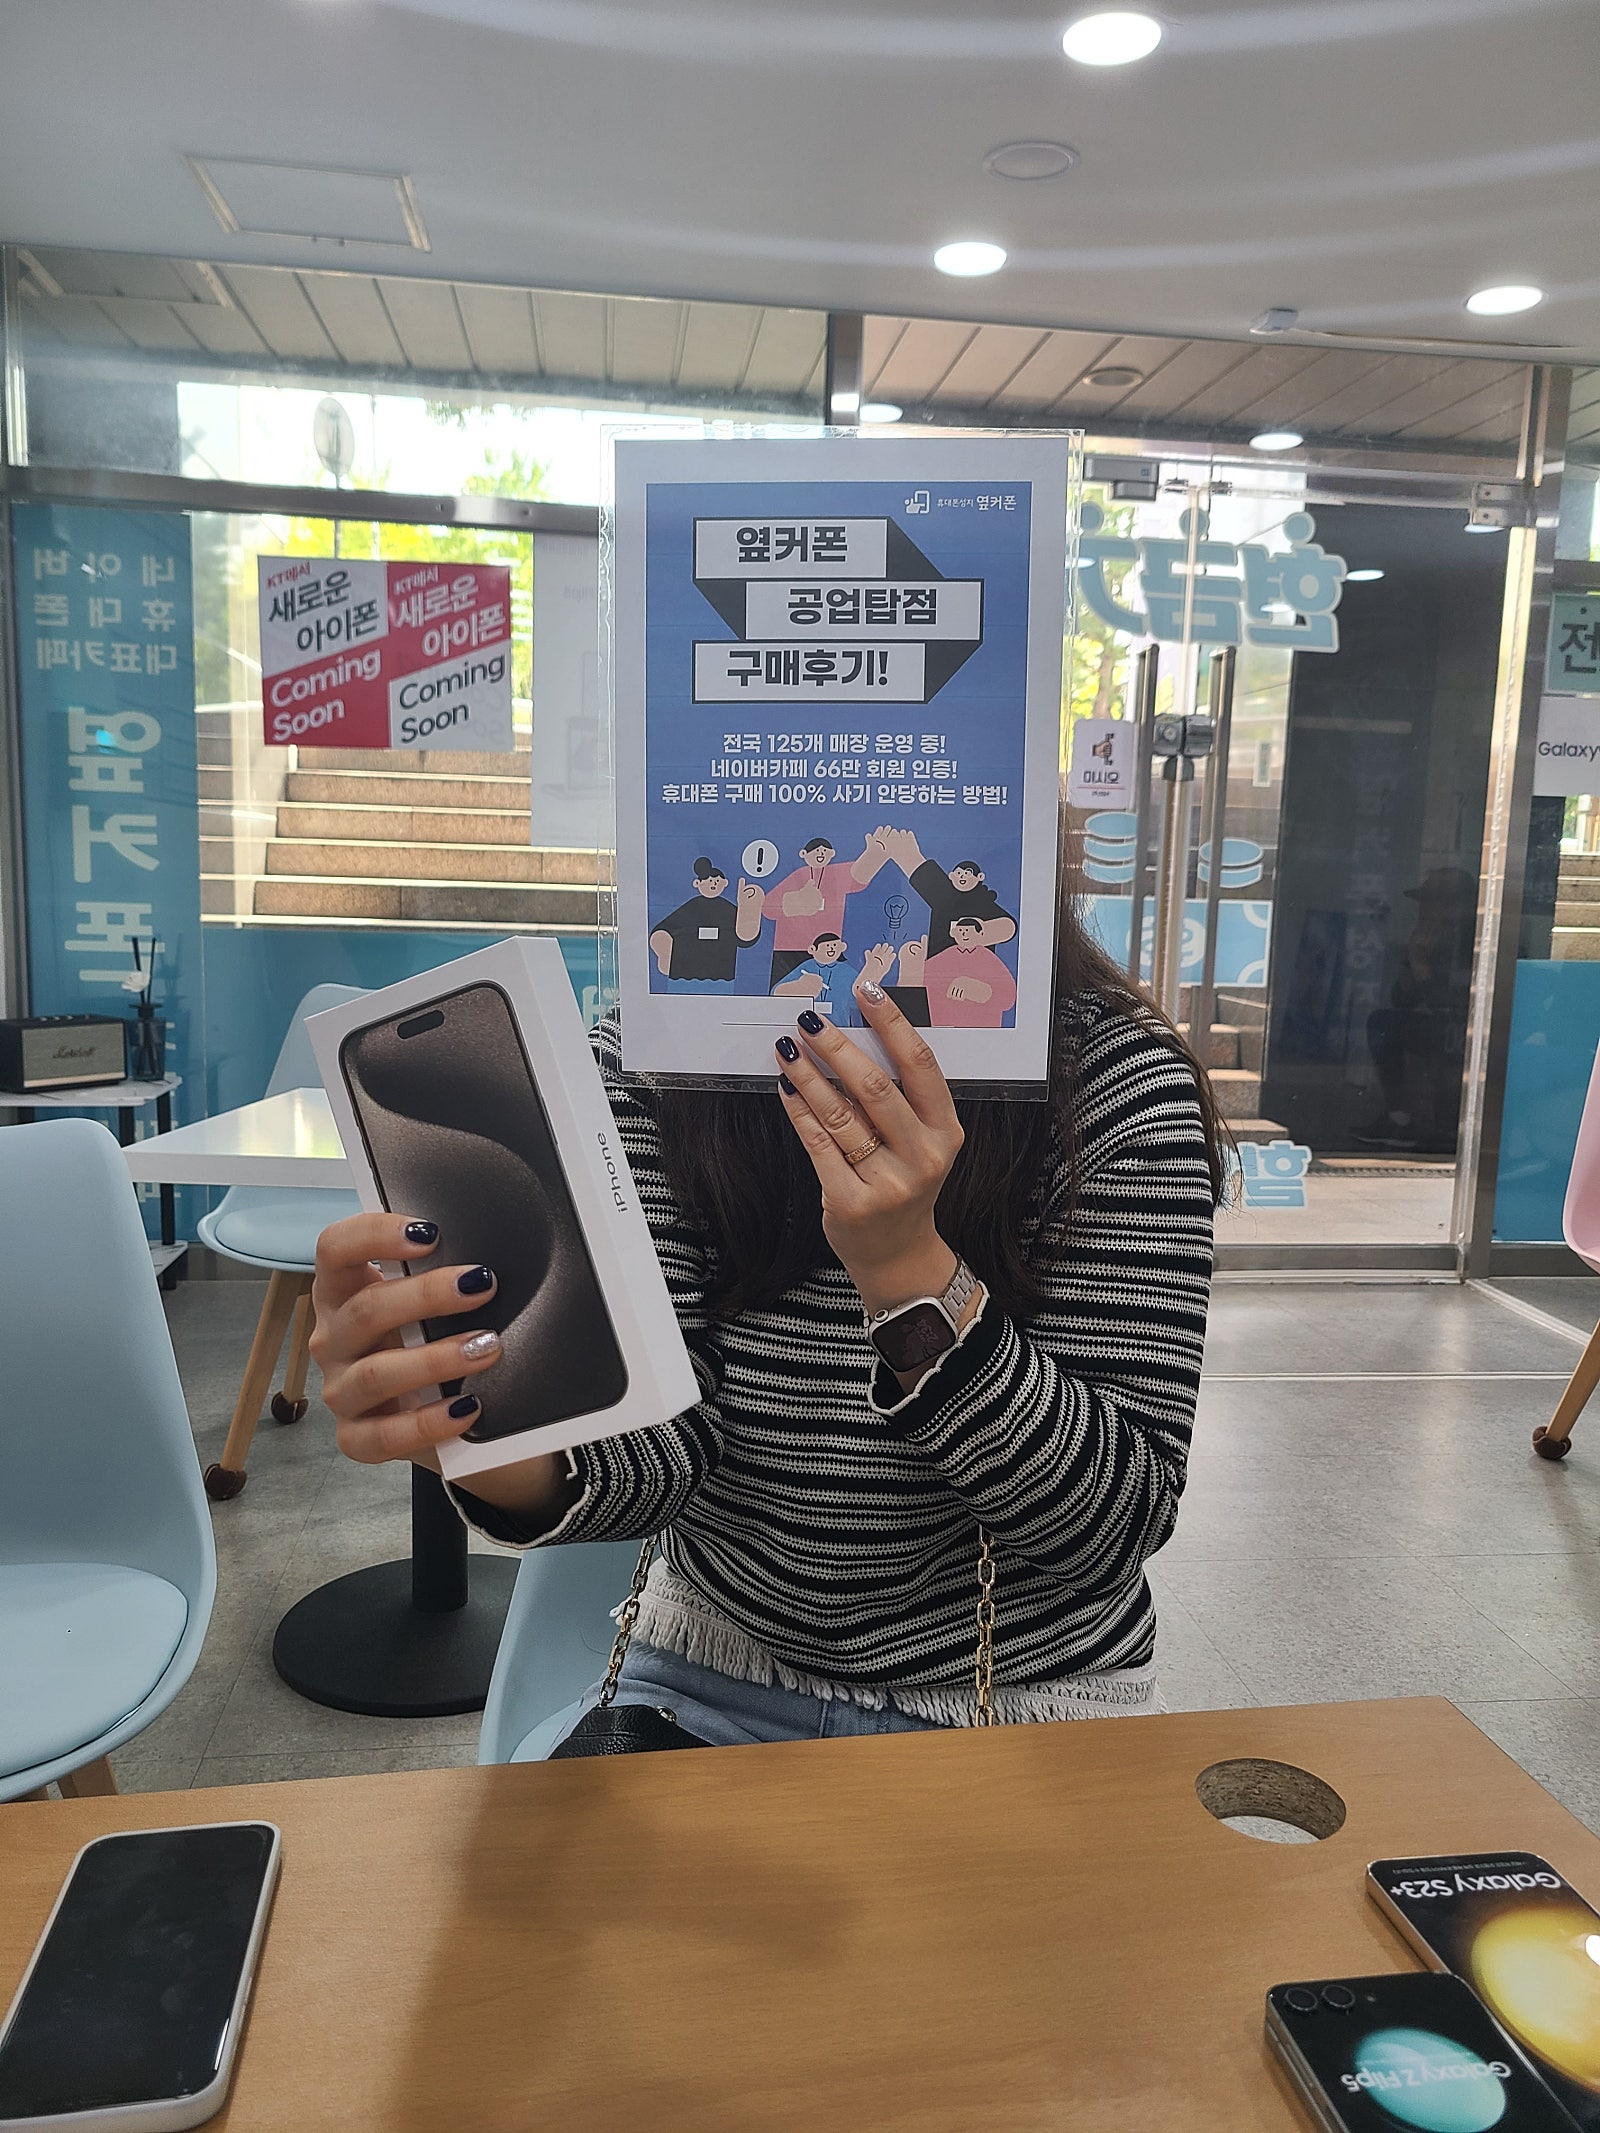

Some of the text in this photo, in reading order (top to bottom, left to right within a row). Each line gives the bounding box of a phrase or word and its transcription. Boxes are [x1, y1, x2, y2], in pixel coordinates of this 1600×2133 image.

[937, 495, 1017, 511] 휴대폰성지 옆커폰
[736, 525, 849, 564] 옆커폰
[267, 561, 312, 589] KT에서
[393, 566, 439, 595] KT에서
[269, 569, 352, 622] 새로운
[396, 573, 479, 628] 새로운
[787, 588, 938, 625] 공업탑점
[297, 599, 379, 652] 아이폰
[422, 603, 506, 657] 아이폰
[270, 649, 382, 708] Coming
[399, 654, 506, 710] Coming
[727, 649, 889, 688] 구매후기!
[272, 698, 346, 742] Soon
[401, 703, 470, 744] Soon
[723, 734, 946, 754] 전국 125개 매장 운영 중!
[1538, 741, 1600, 762] Galaxy
[711, 759, 958, 779] 네이버카페 66만 회원 인증!
[1083, 770, 1120, 784] 미시오
[662, 784, 1008, 805] 휴대폰 구매 100% 사기 안당하는 방법!
[597, 1132, 628, 1213] iPhone
[1390, 1871, 1561, 1899] Galaxy S23+
[1340, 2060, 1512, 2093] Galaxy Z Flip5
